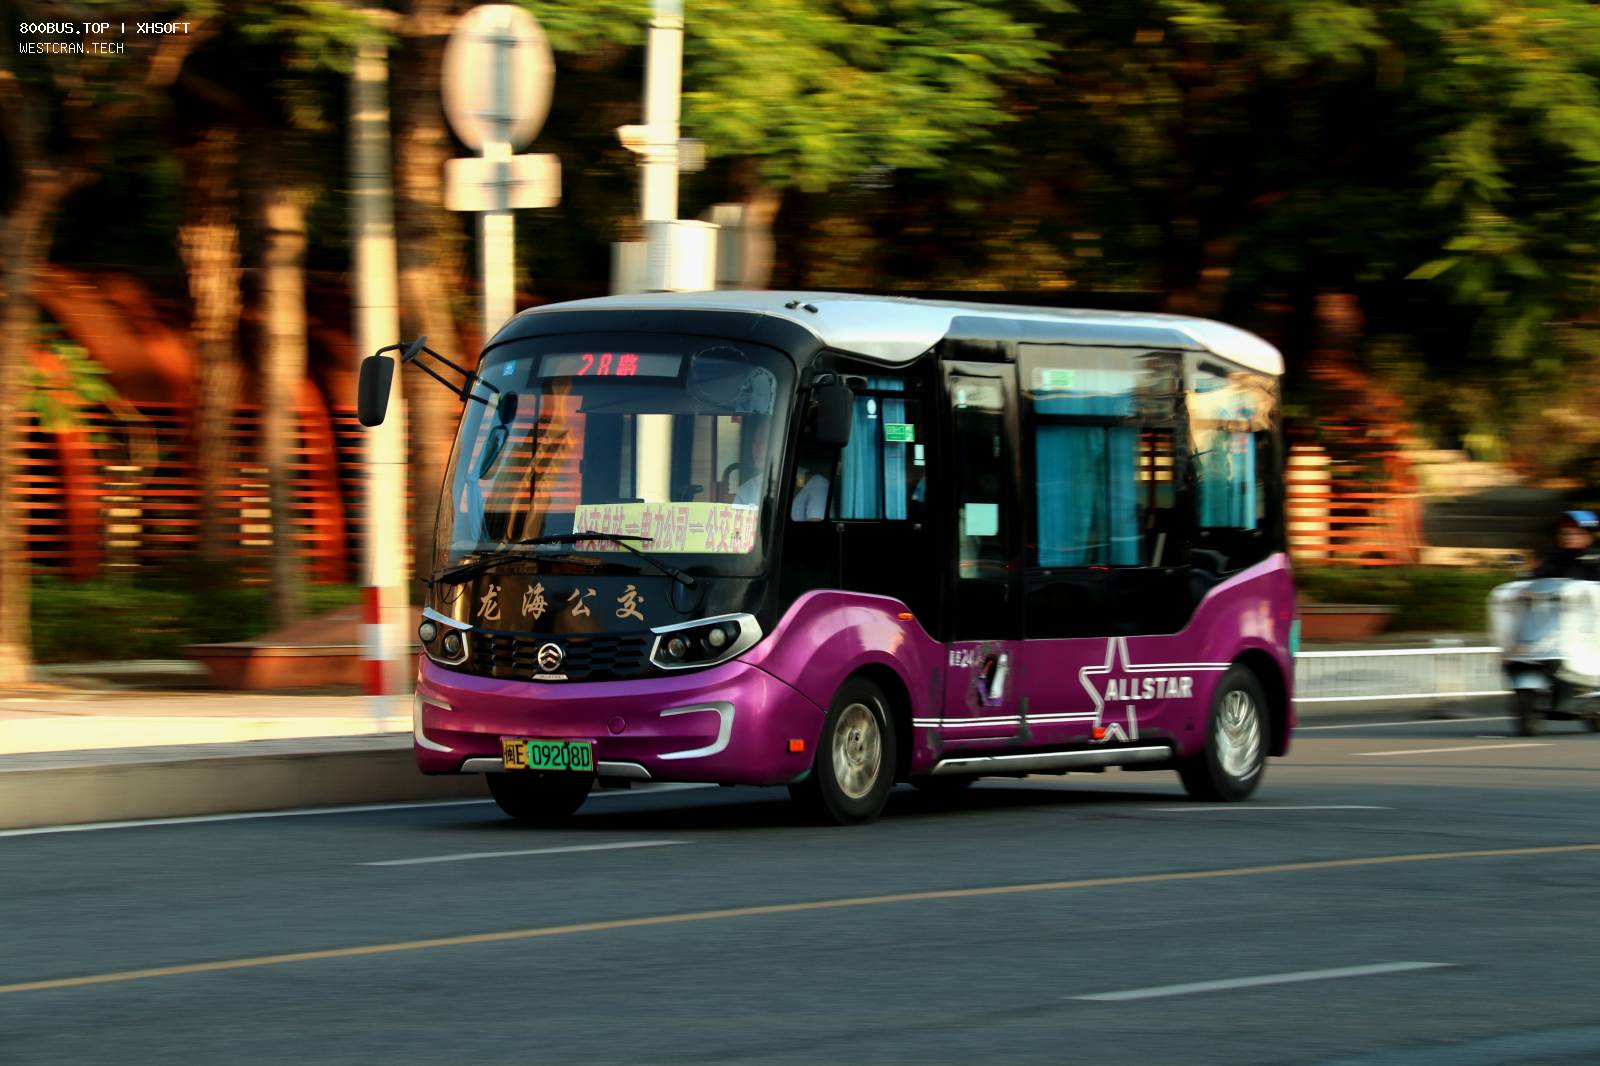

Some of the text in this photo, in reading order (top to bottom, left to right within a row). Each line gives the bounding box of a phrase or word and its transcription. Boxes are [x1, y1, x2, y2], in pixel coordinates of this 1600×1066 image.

[477, 582, 644, 622] 龙海公交
[1104, 676, 1194, 701] ALLSTAR
